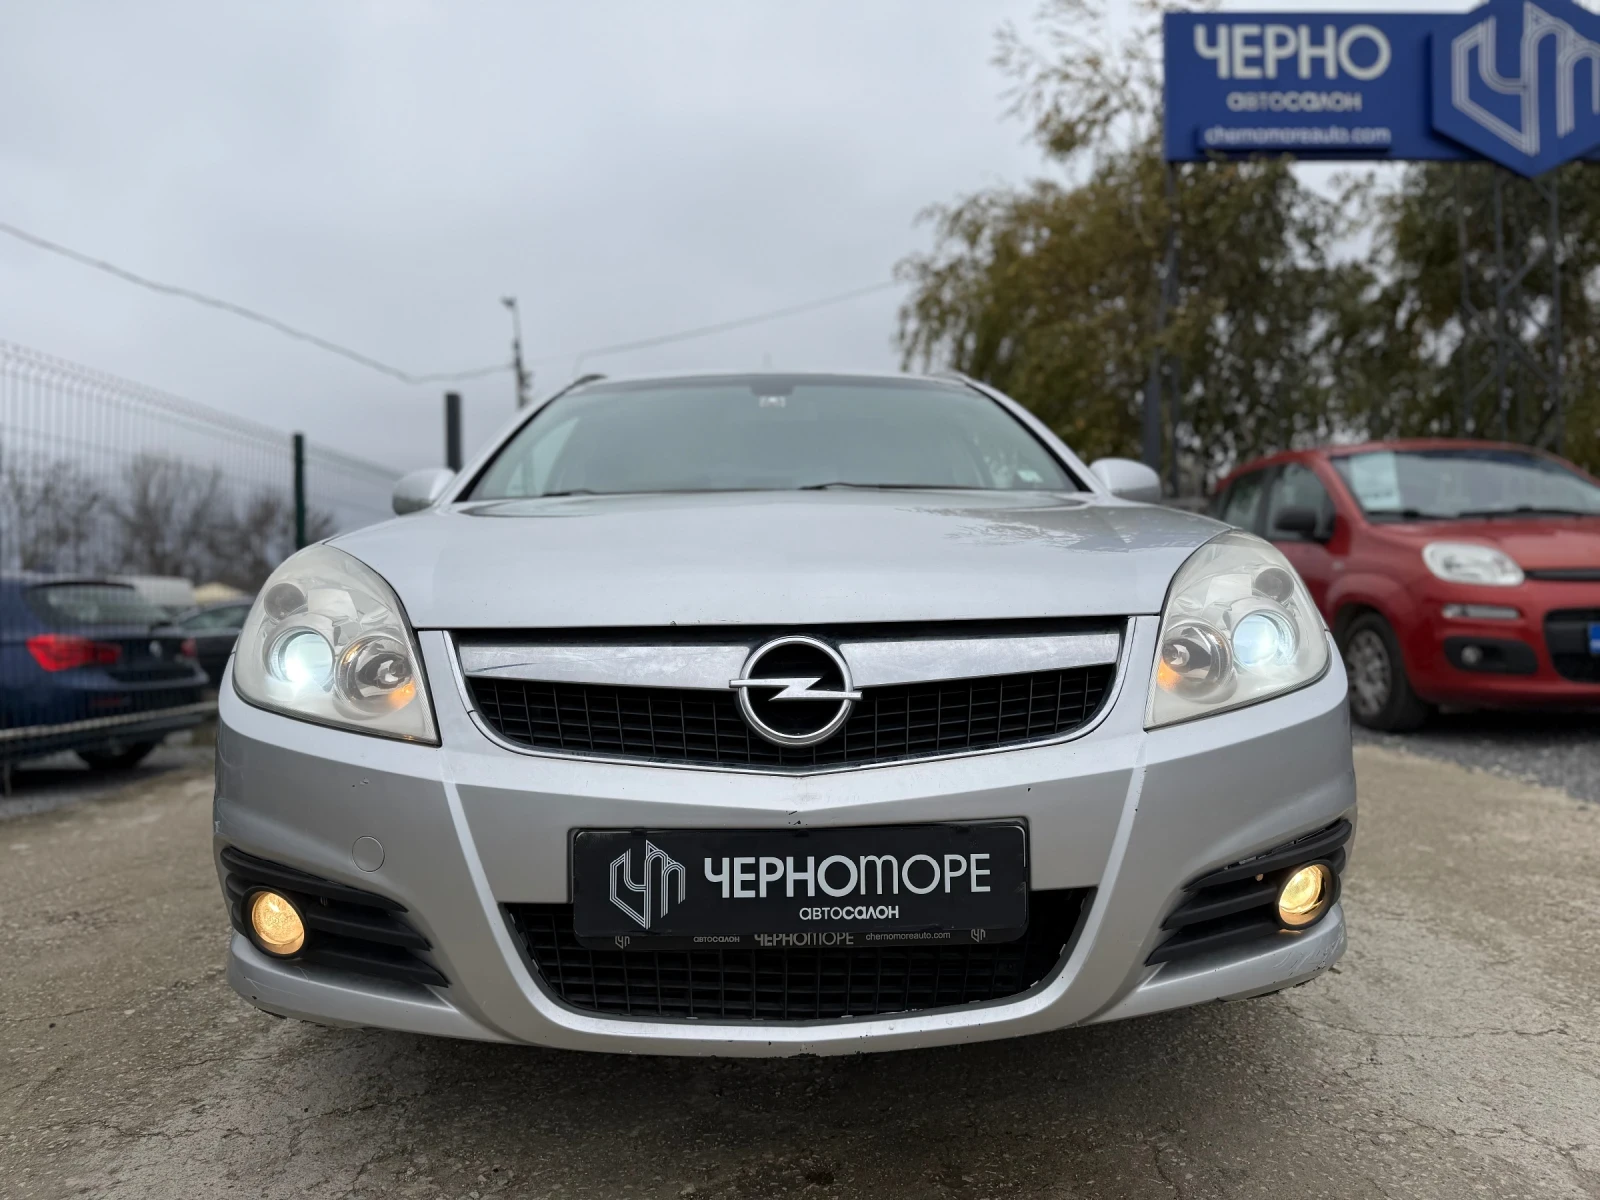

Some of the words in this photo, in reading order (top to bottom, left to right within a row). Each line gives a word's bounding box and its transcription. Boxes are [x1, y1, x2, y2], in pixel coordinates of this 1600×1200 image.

[1194, 24, 1392, 80] ЧЕРНО
[799, 905, 900, 920] автосалон
[865, 931, 951, 941] chernomoreauto.com
